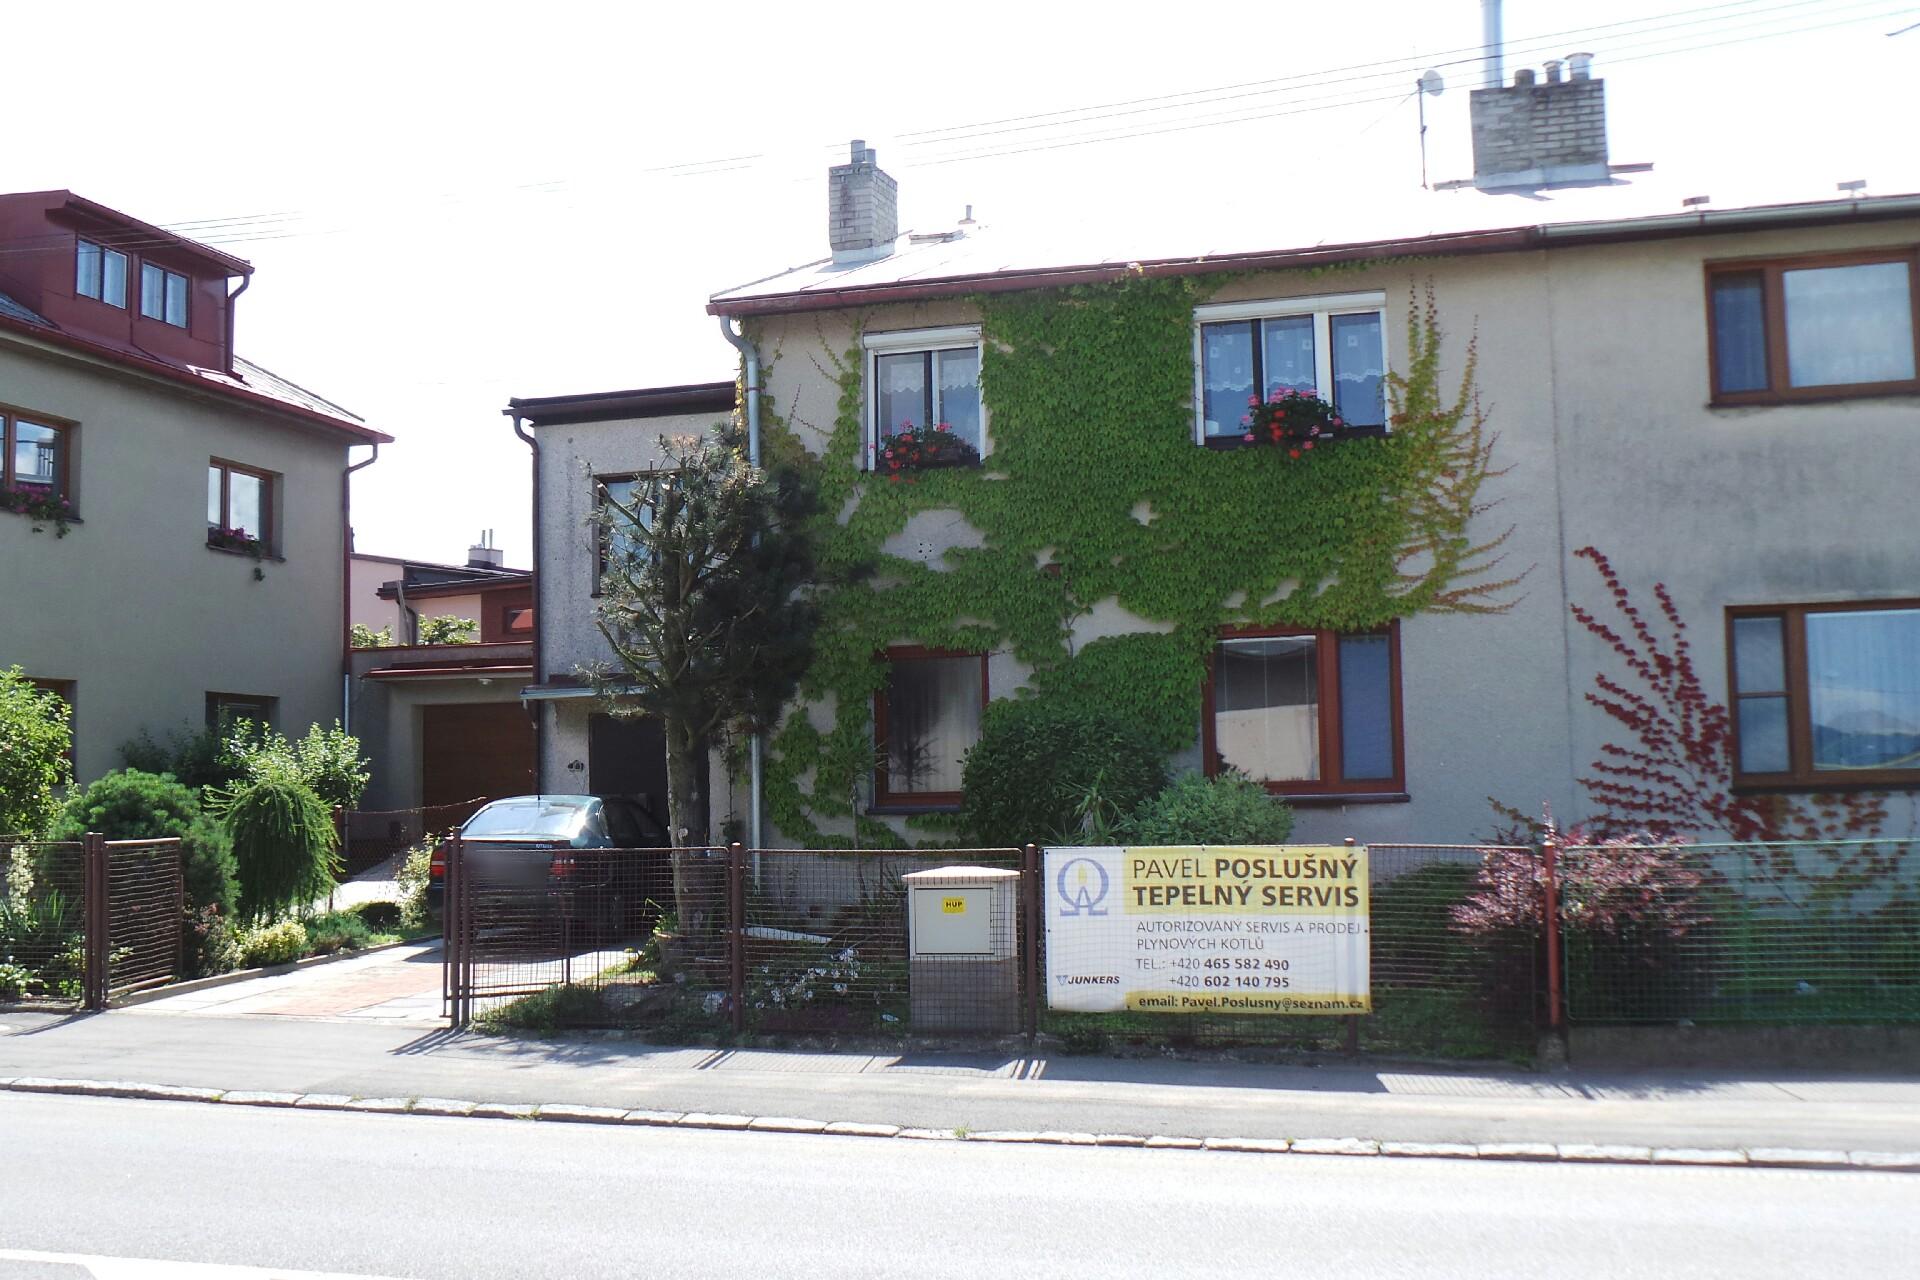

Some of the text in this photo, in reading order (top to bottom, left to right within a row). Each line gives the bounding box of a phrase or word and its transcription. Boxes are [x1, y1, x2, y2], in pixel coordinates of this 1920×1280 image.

[1133, 854, 1358, 879] PAVEL POSLUŠNÝ
[1133, 880, 1359, 907] TEPELNÝ SERVIS
[1137, 919, 1360, 933] AUTORIZOVANÝ SERVIS A PRODEJ
[1137, 936, 1264, 950] PLYNOVÝCH KOTLŮ
[1171, 959, 1200, 970] +420
[1204, 959, 1230, 970] 465
[1235, 959, 1260, 970] 582
[1265, 959, 1289, 971] 490
[1068, 976, 1120, 985] JUNKERS
[1169, 976, 1289, 988] +420 602 140 795
[1139, 996, 1178, 1007] email:
